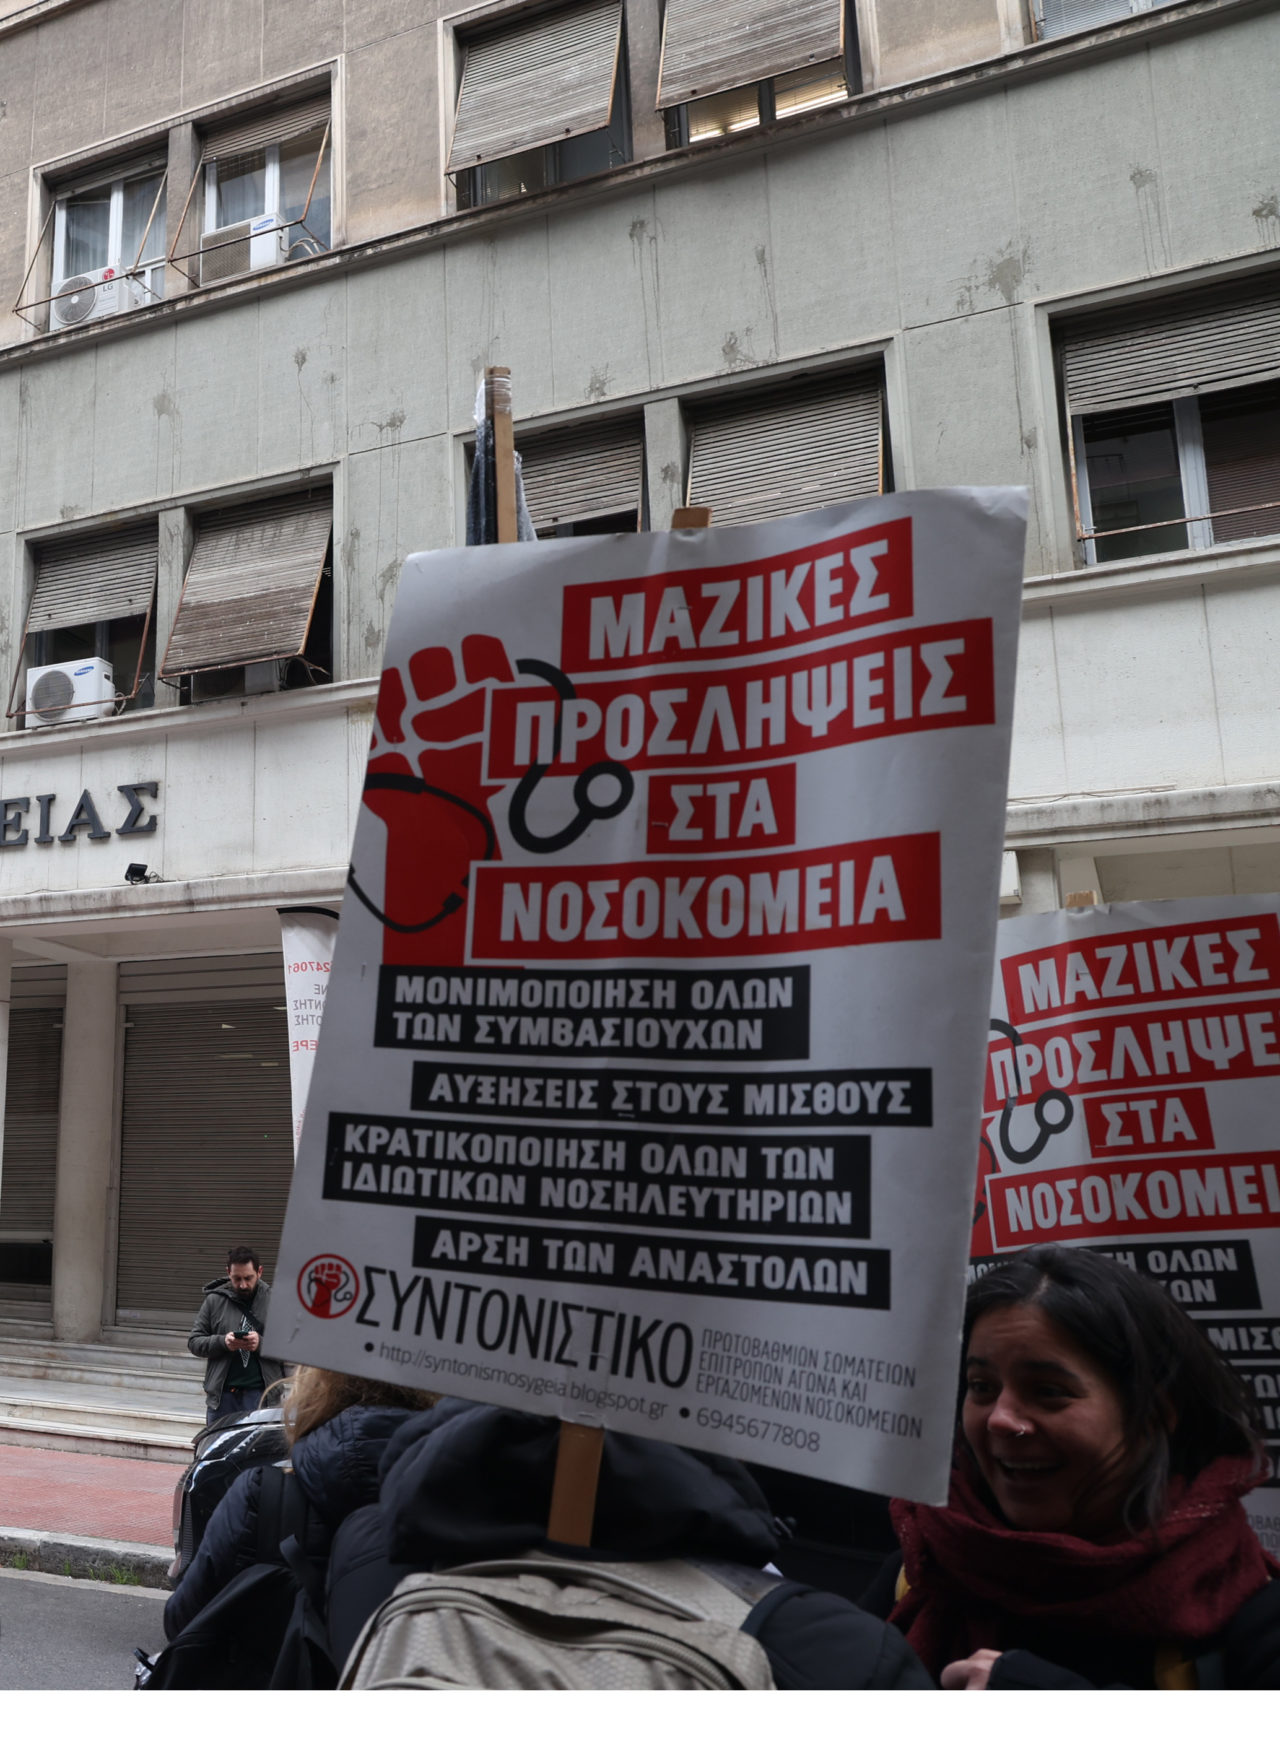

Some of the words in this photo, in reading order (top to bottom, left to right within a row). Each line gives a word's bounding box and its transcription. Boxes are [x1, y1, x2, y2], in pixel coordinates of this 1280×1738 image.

[102, 283, 114, 292] LG
[589, 539, 890, 660] ΜΑΖΙΚΕΣ
[515, 638, 967, 765] ΠΡΟΣΛΗΨΕΙΣ
[667, 779, 778, 841] ΣΤΑ
[500, 855, 906, 942] ΝΟΣΟΚΟΜΕΙΑ
[395, 975, 676, 1010] ΜΟΝΙΜΟΠΟΙΗΣΗ
[691, 977, 794, 1009] ΟΛΩΝ
[1018, 928, 1270, 1014] ΜΑΖΙΚΕΣ
[394, 1012, 462, 1043] ΤΩΝ
[474, 1015, 763, 1050] ΣΥΜΒΑΣΙΟΥΧΩΝ
[429, 1073, 598, 1109] ΑΥΞΗΣΕΙΣ
[611, 1079, 729, 1115] ΣΤΟΥΣ
[744, 1081, 911, 1115] ΜΙΣΘΟΥΣ
[1105, 1098, 1198, 1146] ΣΤΑ
[343, 1124, 626, 1173] ΚΡΑΤΙΚΟΠΟΙΗΣΗ
[641, 1142, 747, 1178] ΟΛΩΝ
[761, 1147, 834, 1181] ΤΩΝ
[342, 1161, 524, 1203] ΙΔΙΩΤΙΚΩΝ
[540, 1177, 851, 1226] ΝΟΣΗΛΕΥΤΗΡΙΩΝ
[431, 1228, 529, 1267] ΑΡΣΗ
[543, 1238, 614, 1274] ΤΩΝ
[629, 1246, 868, 1295] ΑΝΑΣΤΟΛΩΝ
[1148, 1248, 1239, 1273] ΟΛΩΝ
[355, 1265, 693, 1389] ΣΥΝΤΟΝΙΣΤΙΚΟ
[699, 1351, 783, 1385] ΕΠΙΤΡΟΠΩΝ
[788, 1369, 837, 1397] ΑΓΩΝΑ
[841, 1382, 868, 1402] ΚΑΙ
[702, 1328, 819, 1369] ΠΡΩΤΟΒΑΘΜΙΩΝ
[823, 1351, 916, 1388] ΣΩΜΑΤΕΙΩΝ
[696, 1372, 802, 1413] ΕΡΓΑΖΟΜΕΝΩΝ
[804, 1396, 923, 1438] ΝΟΣΟΚΟΜΕΙΩΝ
[696, 1407, 820, 1452] 6945677808
